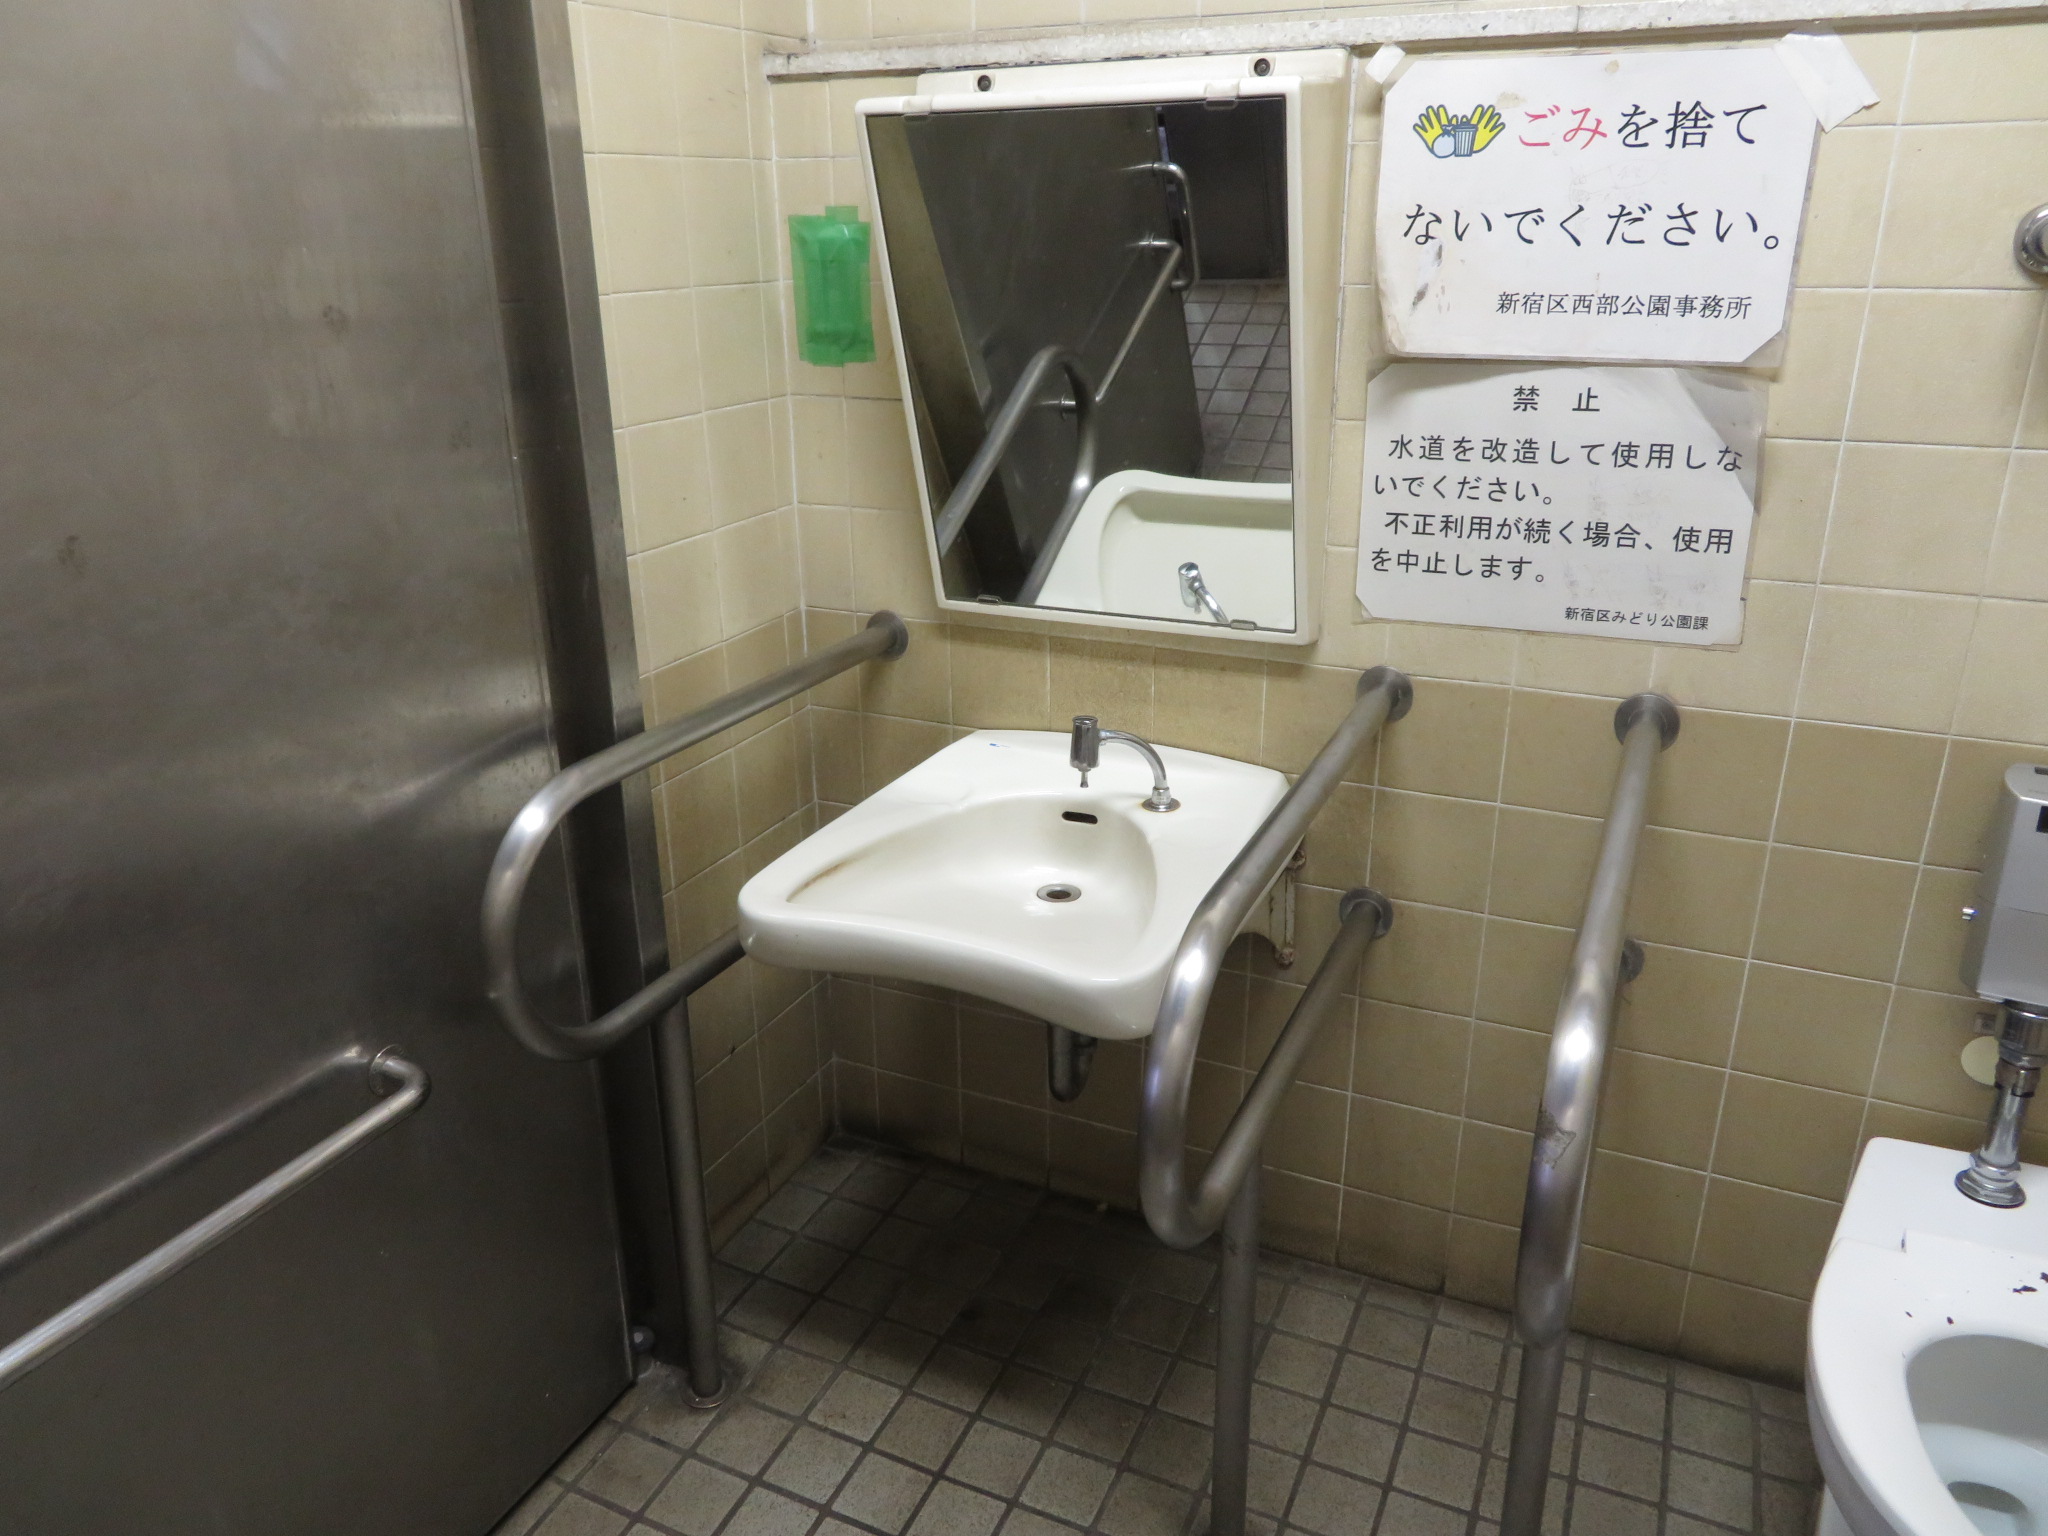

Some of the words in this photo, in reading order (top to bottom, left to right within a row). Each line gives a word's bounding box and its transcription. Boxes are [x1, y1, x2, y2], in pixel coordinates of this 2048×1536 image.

[1518, 100, 1767, 151] ごみを捨て
[1403, 202, 1780, 250] ないでください。
[1496, 291, 1753, 321] 新宿区西部公園事務所
[1388, 434, 1743, 472] 水道を改造して使用しな
[1374, 473, 1553, 506] いでください。
[1371, 547, 1546, 584] を中止します。
[1564, 606, 1709, 631] 新宿区みどり公園課
